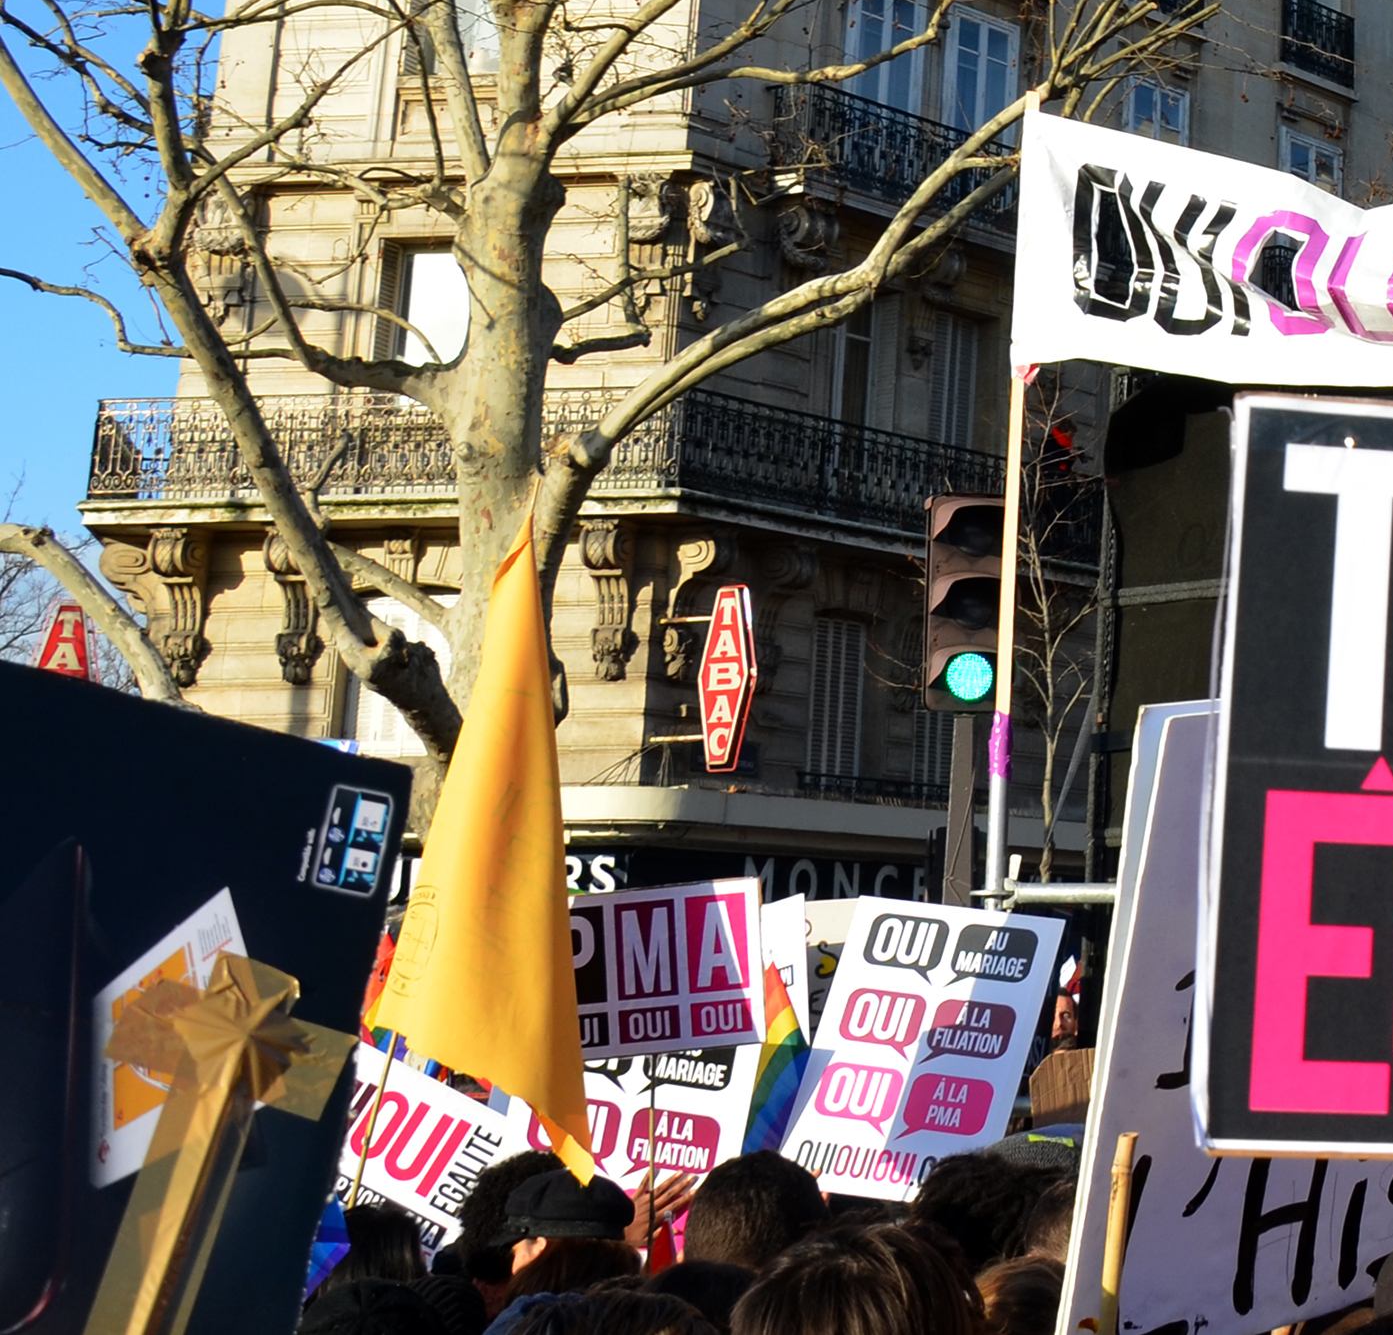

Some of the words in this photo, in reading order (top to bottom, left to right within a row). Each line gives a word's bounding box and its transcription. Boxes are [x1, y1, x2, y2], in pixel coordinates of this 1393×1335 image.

[707, 597, 742, 757] TABAC
[871, 917, 940, 967] OUI
[985, 930, 1010, 951] AU
[955, 950, 1028, 979] MARIAGE
[628, 1009, 672, 1040] OUI
[700, 1002, 743, 1034] OUI
[847, 992, 917, 1043] OUI
[956, 1002, 970, 1027] À
[970, 1007, 991, 1029] LA
[931, 1026, 1004, 1055] FILIATION
[823, 1066, 894, 1118] OUI
[932, 1077, 946, 1101] À
[946, 1083, 968, 1104] LA
[671, 1118, 694, 1142] LA
[924, 1105, 962, 1129] PMA
